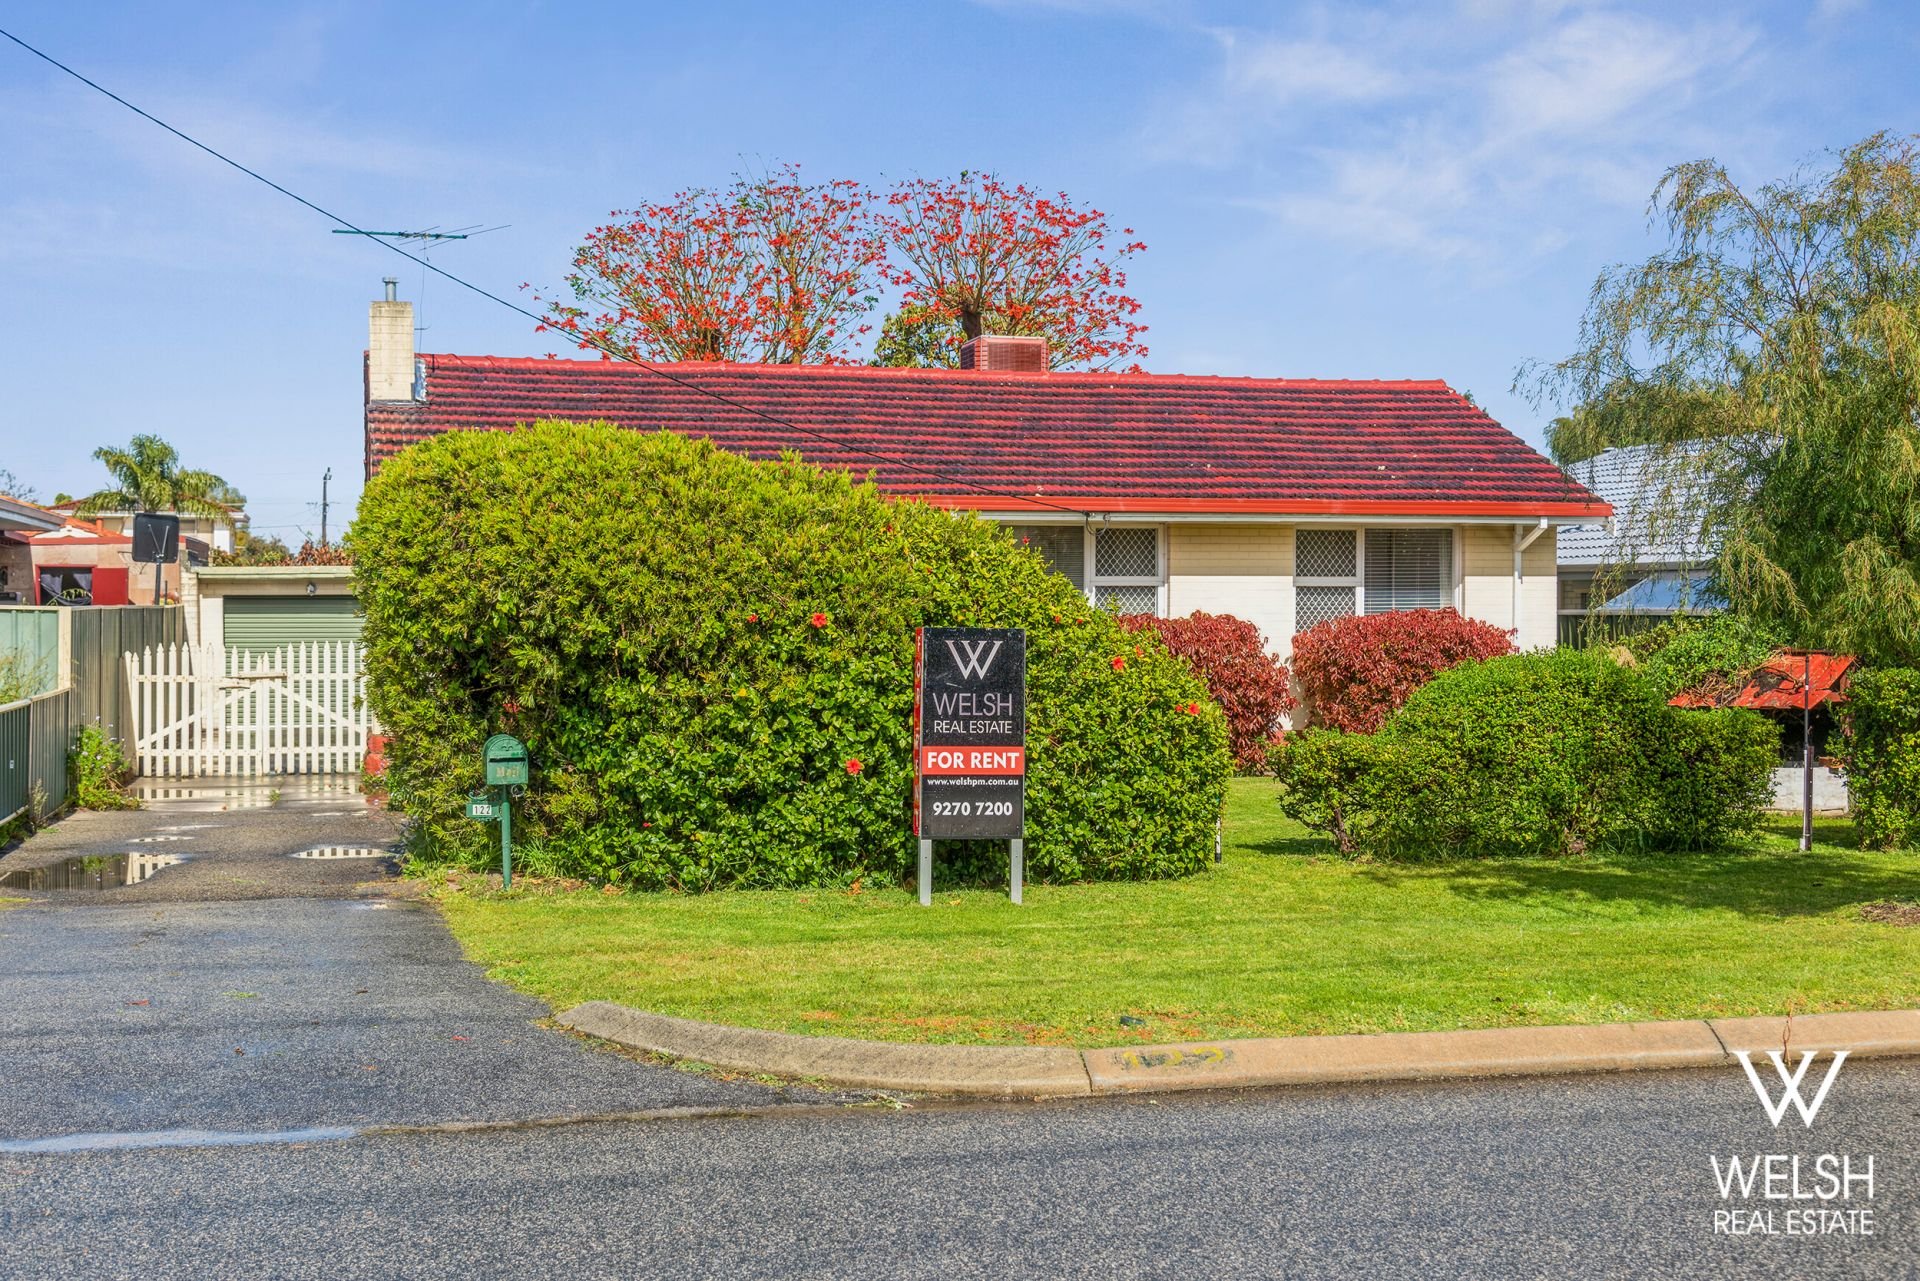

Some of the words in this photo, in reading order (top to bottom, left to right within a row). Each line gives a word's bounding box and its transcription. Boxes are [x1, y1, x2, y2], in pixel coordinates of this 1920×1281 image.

[944, 640, 1004, 680] W
[932, 692, 1013, 717] WELSH
[934, 720, 967, 734] REAL
[969, 720, 1013, 734] ESTATE
[927, 751, 965, 769] FOR
[970, 751, 1020, 769] RENT
[927, 777, 1019, 787] www.welshpm.com.au
[474, 805, 491, 815] 122
[932, 801, 971, 816] 9270
[975, 801, 1013, 816] 7200
